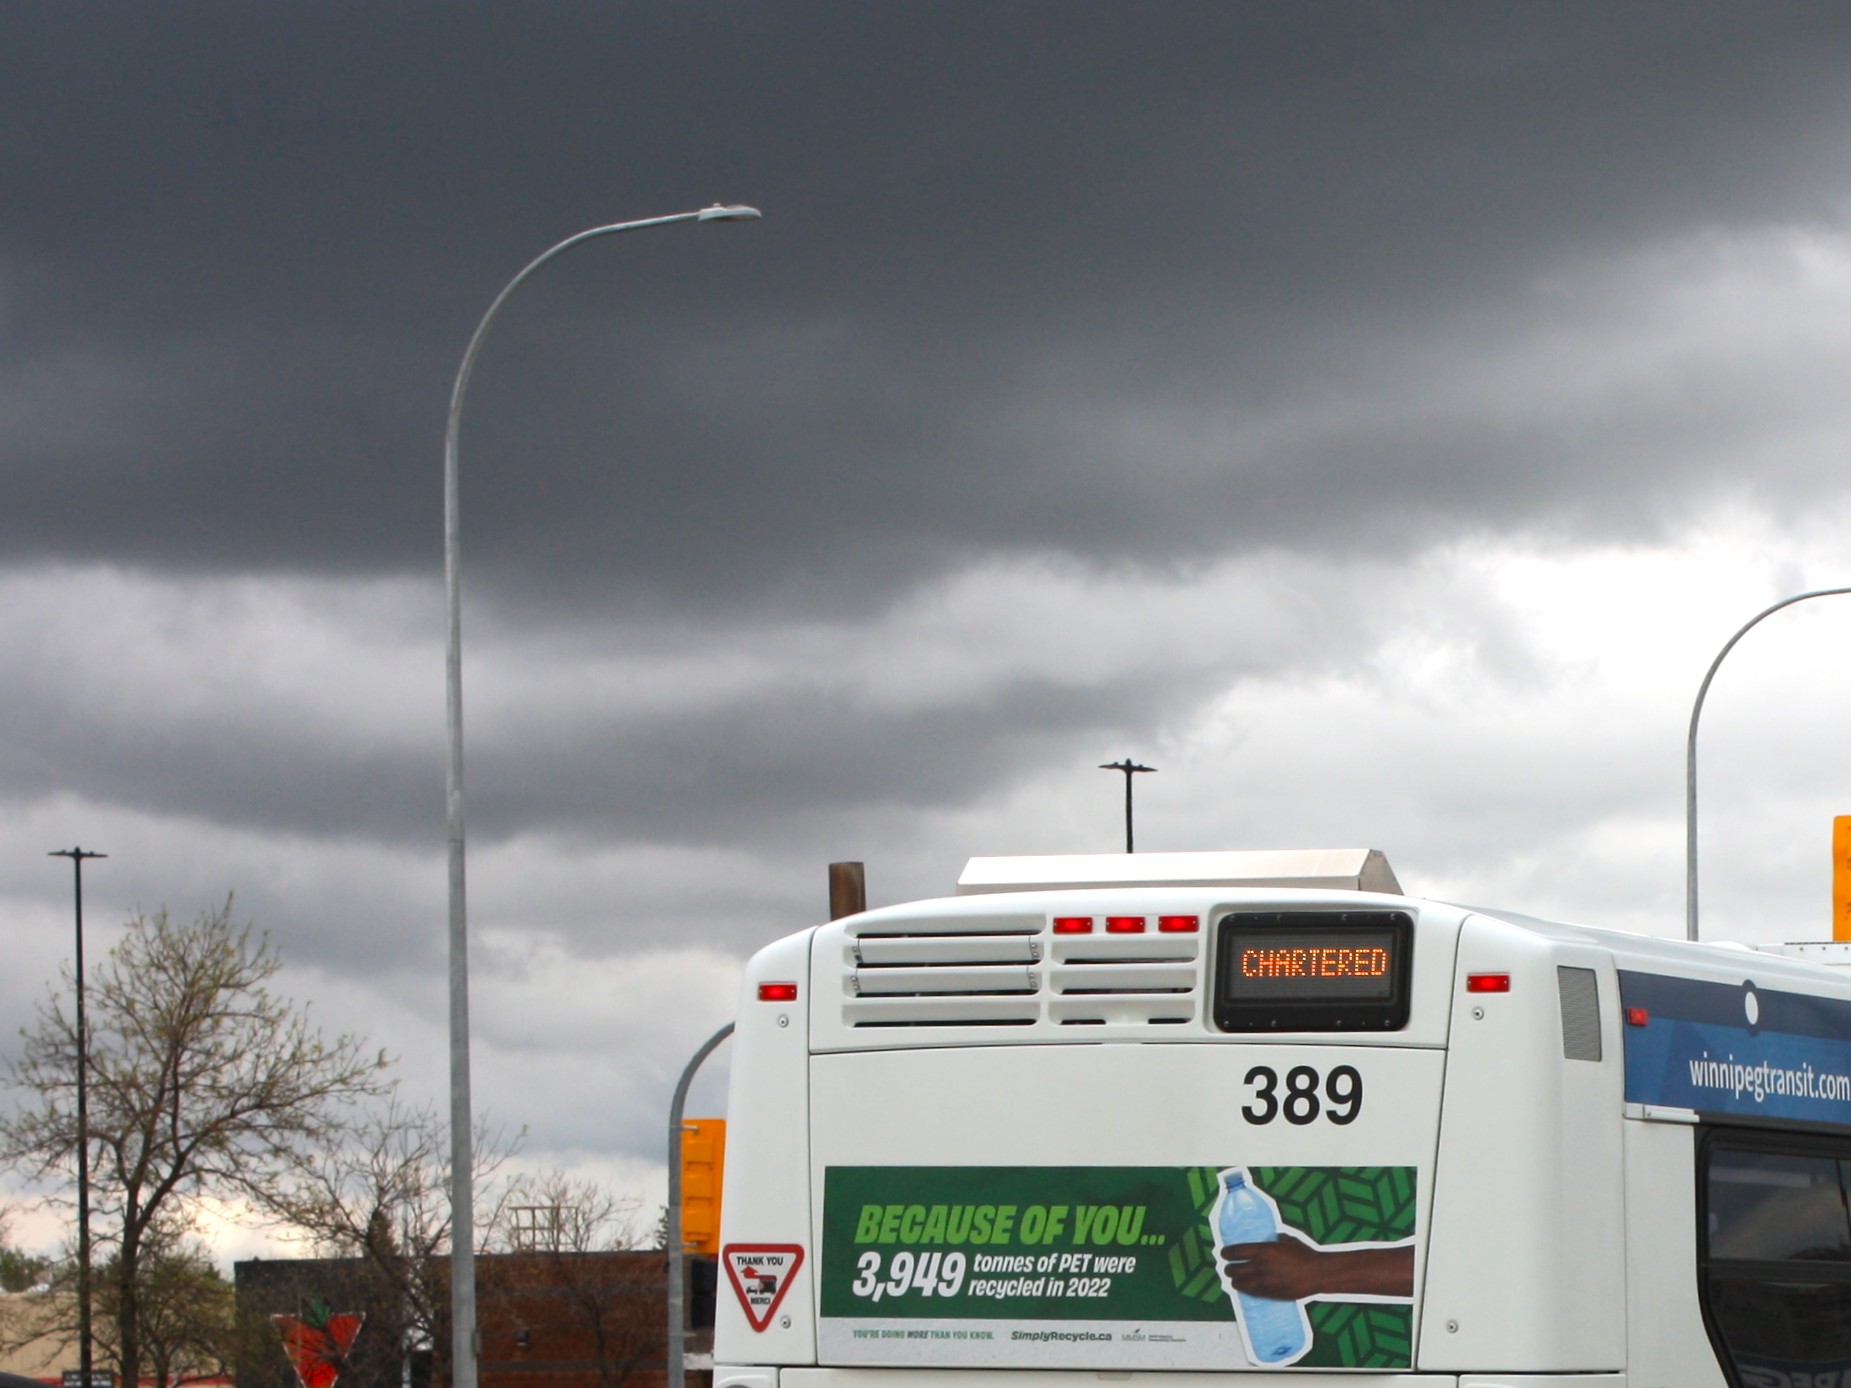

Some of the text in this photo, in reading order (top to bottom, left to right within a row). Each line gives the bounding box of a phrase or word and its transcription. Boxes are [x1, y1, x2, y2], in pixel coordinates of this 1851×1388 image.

[1241, 947, 1390, 977] CHARTERED
[1689, 1050, 1851, 1103] winnipegtransit.com
[1241, 1064, 1363, 1126] 389
[853, 1204, 1166, 1246] BECAUSE OF YOU...
[736, 1256, 784, 1266] THANK YOU
[973, 1253, 1136, 1275] tonnes of PET were
[852, 1251, 967, 1302] 3,949
[967, 1277, 1111, 1299] recycled in 2022
[750, 1296, 771, 1305] MERCI
[881, 1329, 905, 1339] DOING
[906, 1330, 930, 1340] MORE
[930, 1330, 950, 1340] THAN
[952, 1330, 968, 1340] YOU
[1011, 1330, 1113, 1343] SimplyRecycle.ca
